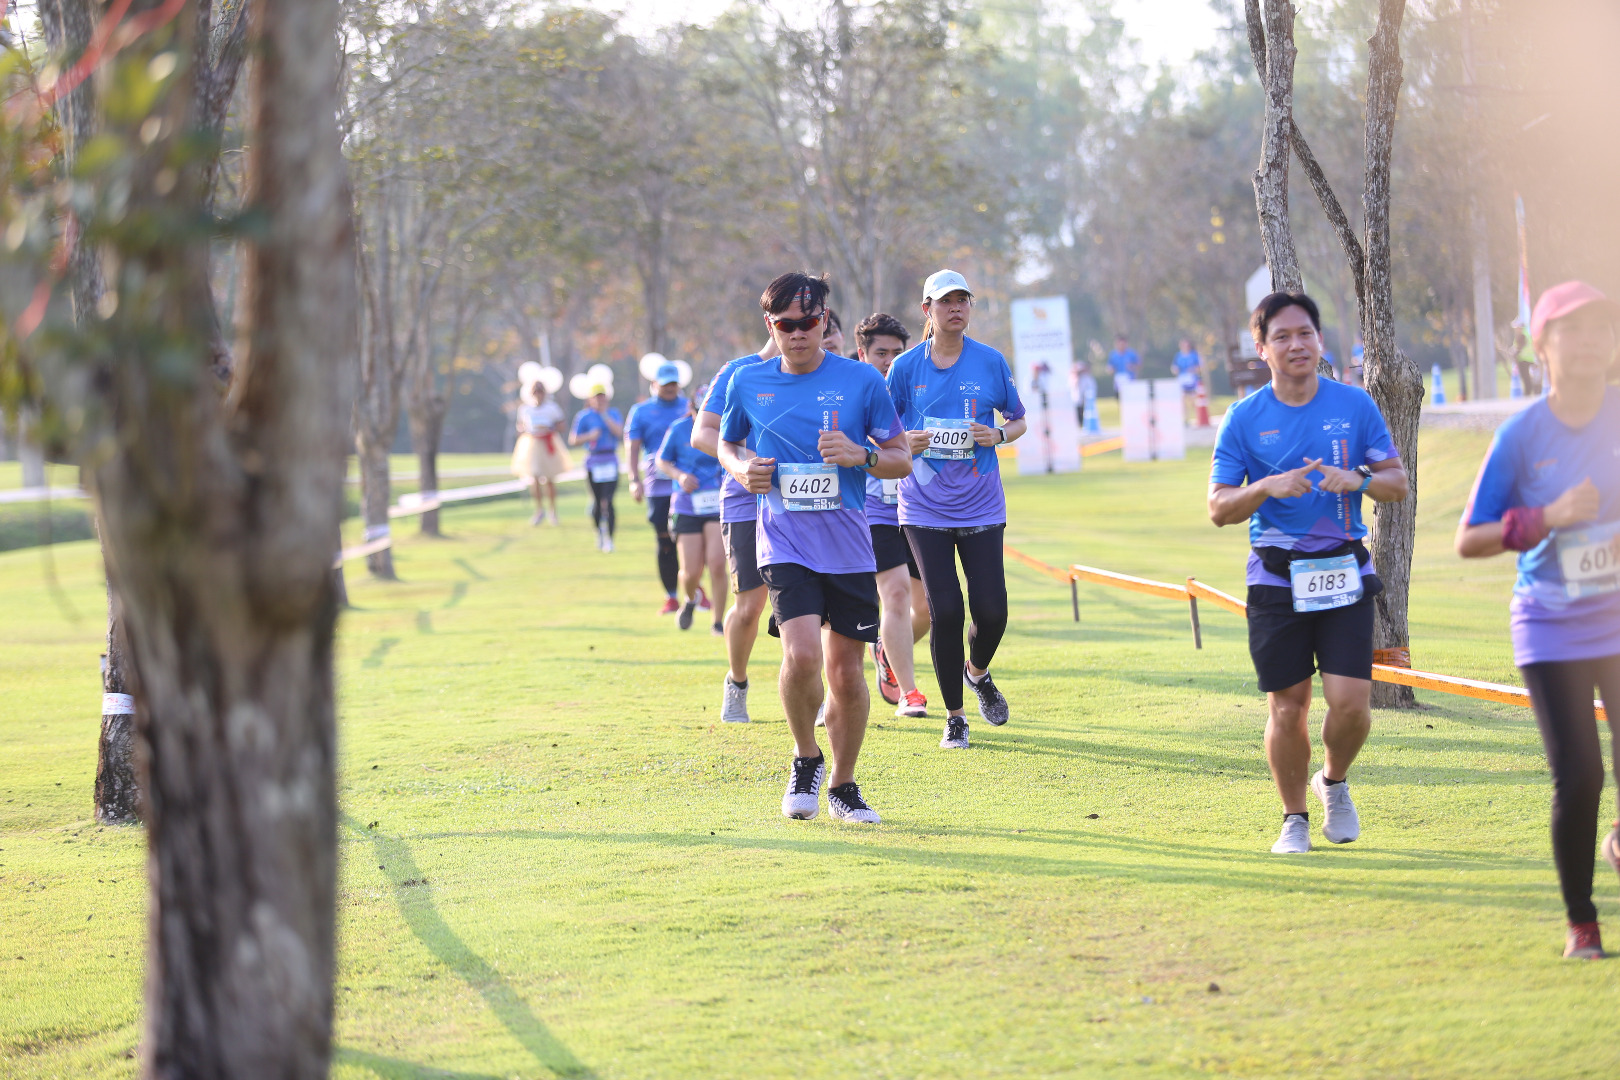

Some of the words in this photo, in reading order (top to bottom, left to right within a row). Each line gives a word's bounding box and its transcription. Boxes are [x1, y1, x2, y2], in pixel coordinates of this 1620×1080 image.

[934, 432, 968, 445] 6009
[1332, 440, 1340, 464] CROSS
[790, 478, 830, 494] 6402
[1308, 574, 1346, 592] 6183
